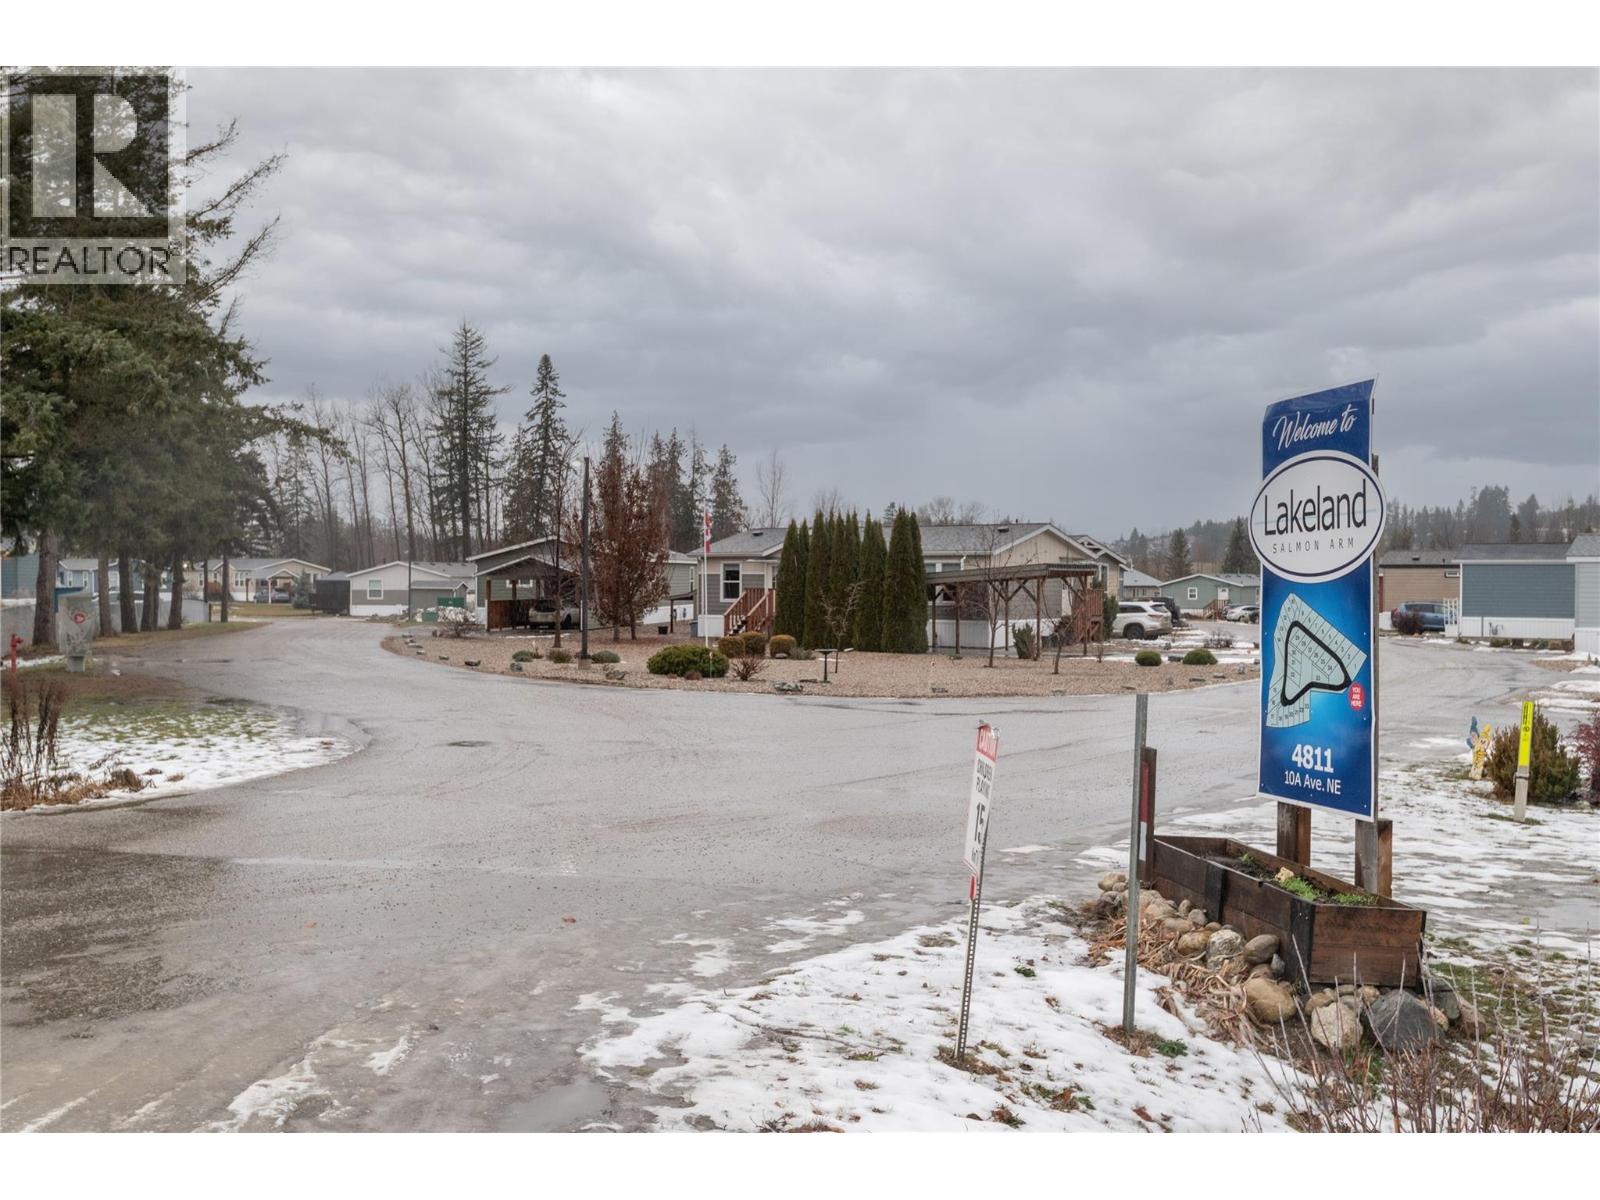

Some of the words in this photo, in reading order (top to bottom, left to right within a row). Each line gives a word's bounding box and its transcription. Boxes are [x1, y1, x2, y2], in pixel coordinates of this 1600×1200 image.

[1272, 411, 1338, 450] Welcome
[1340, 403, 1359, 433] to
[1264, 478, 1367, 536] Lakeland
[1272, 540, 1320, 554] SALMON
[1329, 537, 1354, 550] ARM
[1291, 743, 1335, 773] 4811
[1284, 770, 1302, 787] 10A
[1303, 773, 1325, 792] Ave.
[1326, 778, 1341, 795] NE
